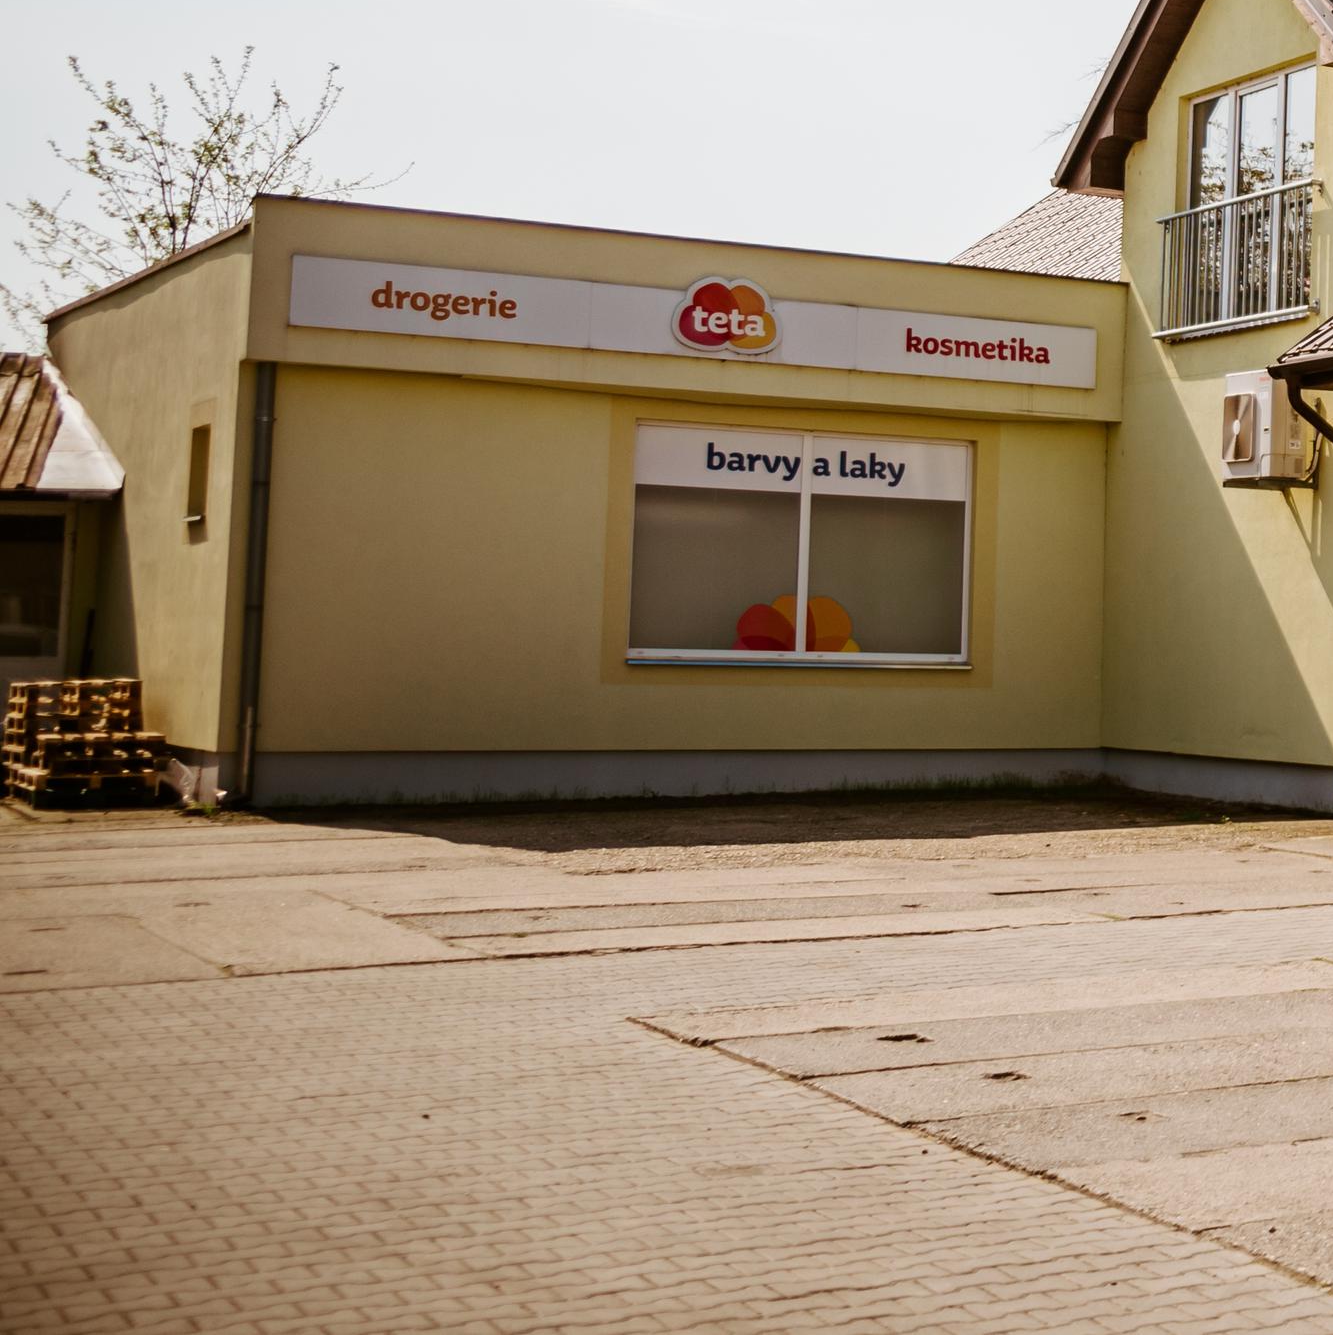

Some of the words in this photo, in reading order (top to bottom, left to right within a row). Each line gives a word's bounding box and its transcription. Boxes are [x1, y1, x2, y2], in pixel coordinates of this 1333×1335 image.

[371, 280, 518, 321] drogerie
[692, 306, 766, 337] teta
[906, 327, 1051, 364] kosmetika
[706, 442, 801, 481] barvy
[812, 457, 831, 477] a
[839, 450, 906, 487] laky
